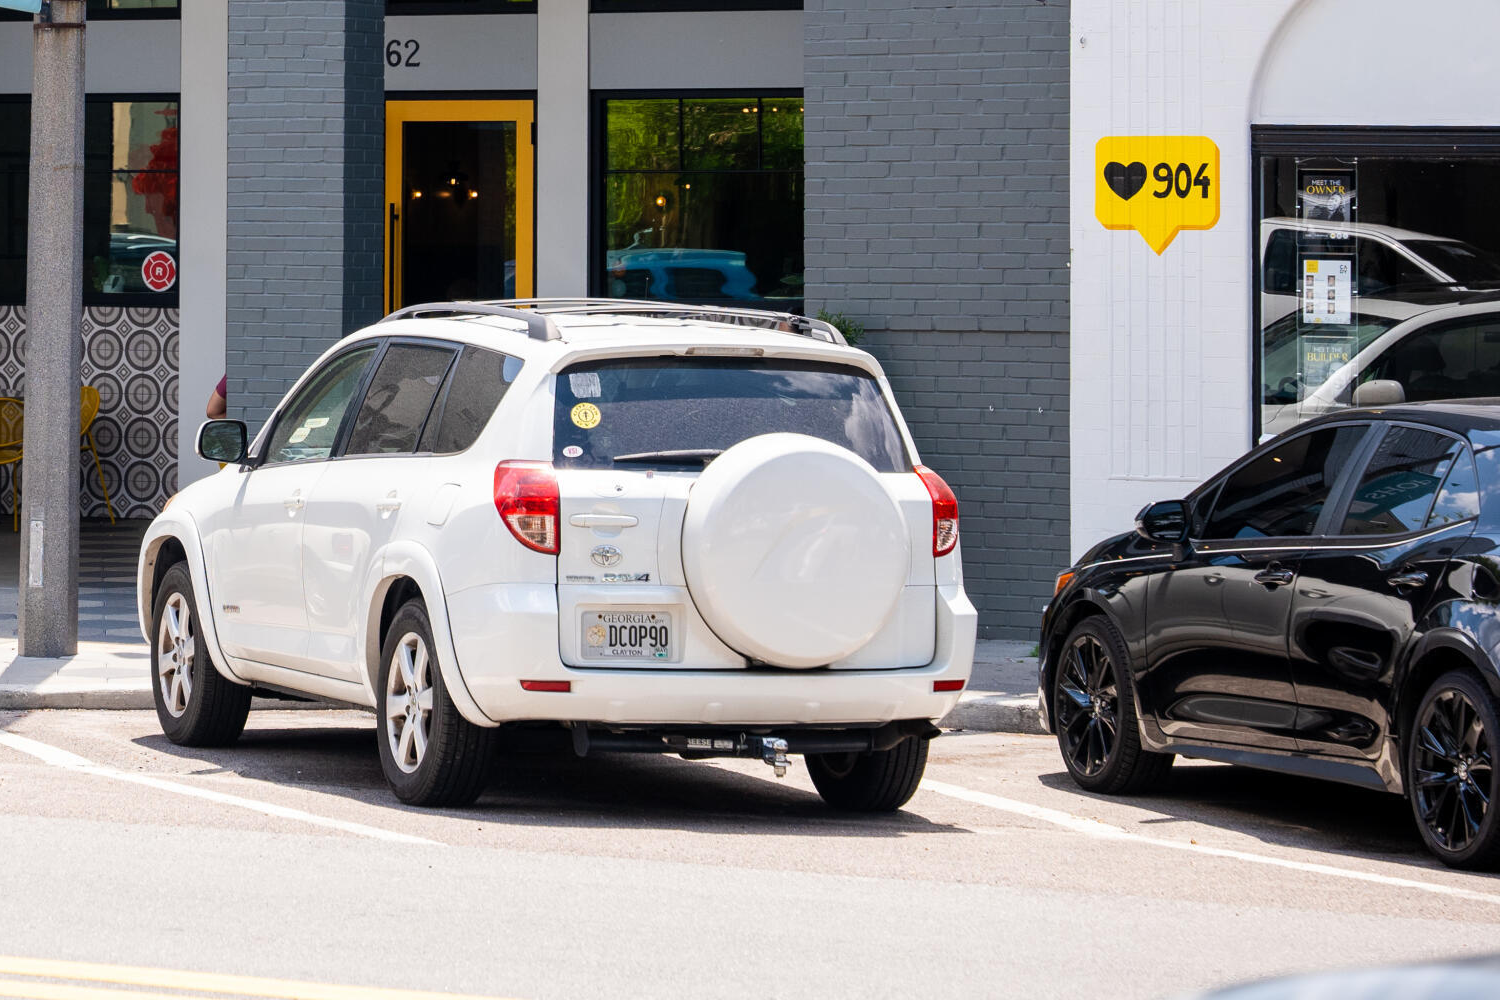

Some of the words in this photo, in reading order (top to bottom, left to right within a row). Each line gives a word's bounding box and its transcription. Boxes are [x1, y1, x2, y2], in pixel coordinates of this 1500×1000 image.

[1152, 162, 1211, 199] 904
[1306, 185, 1346, 195] OWNER
[155, 266, 164, 276] R
